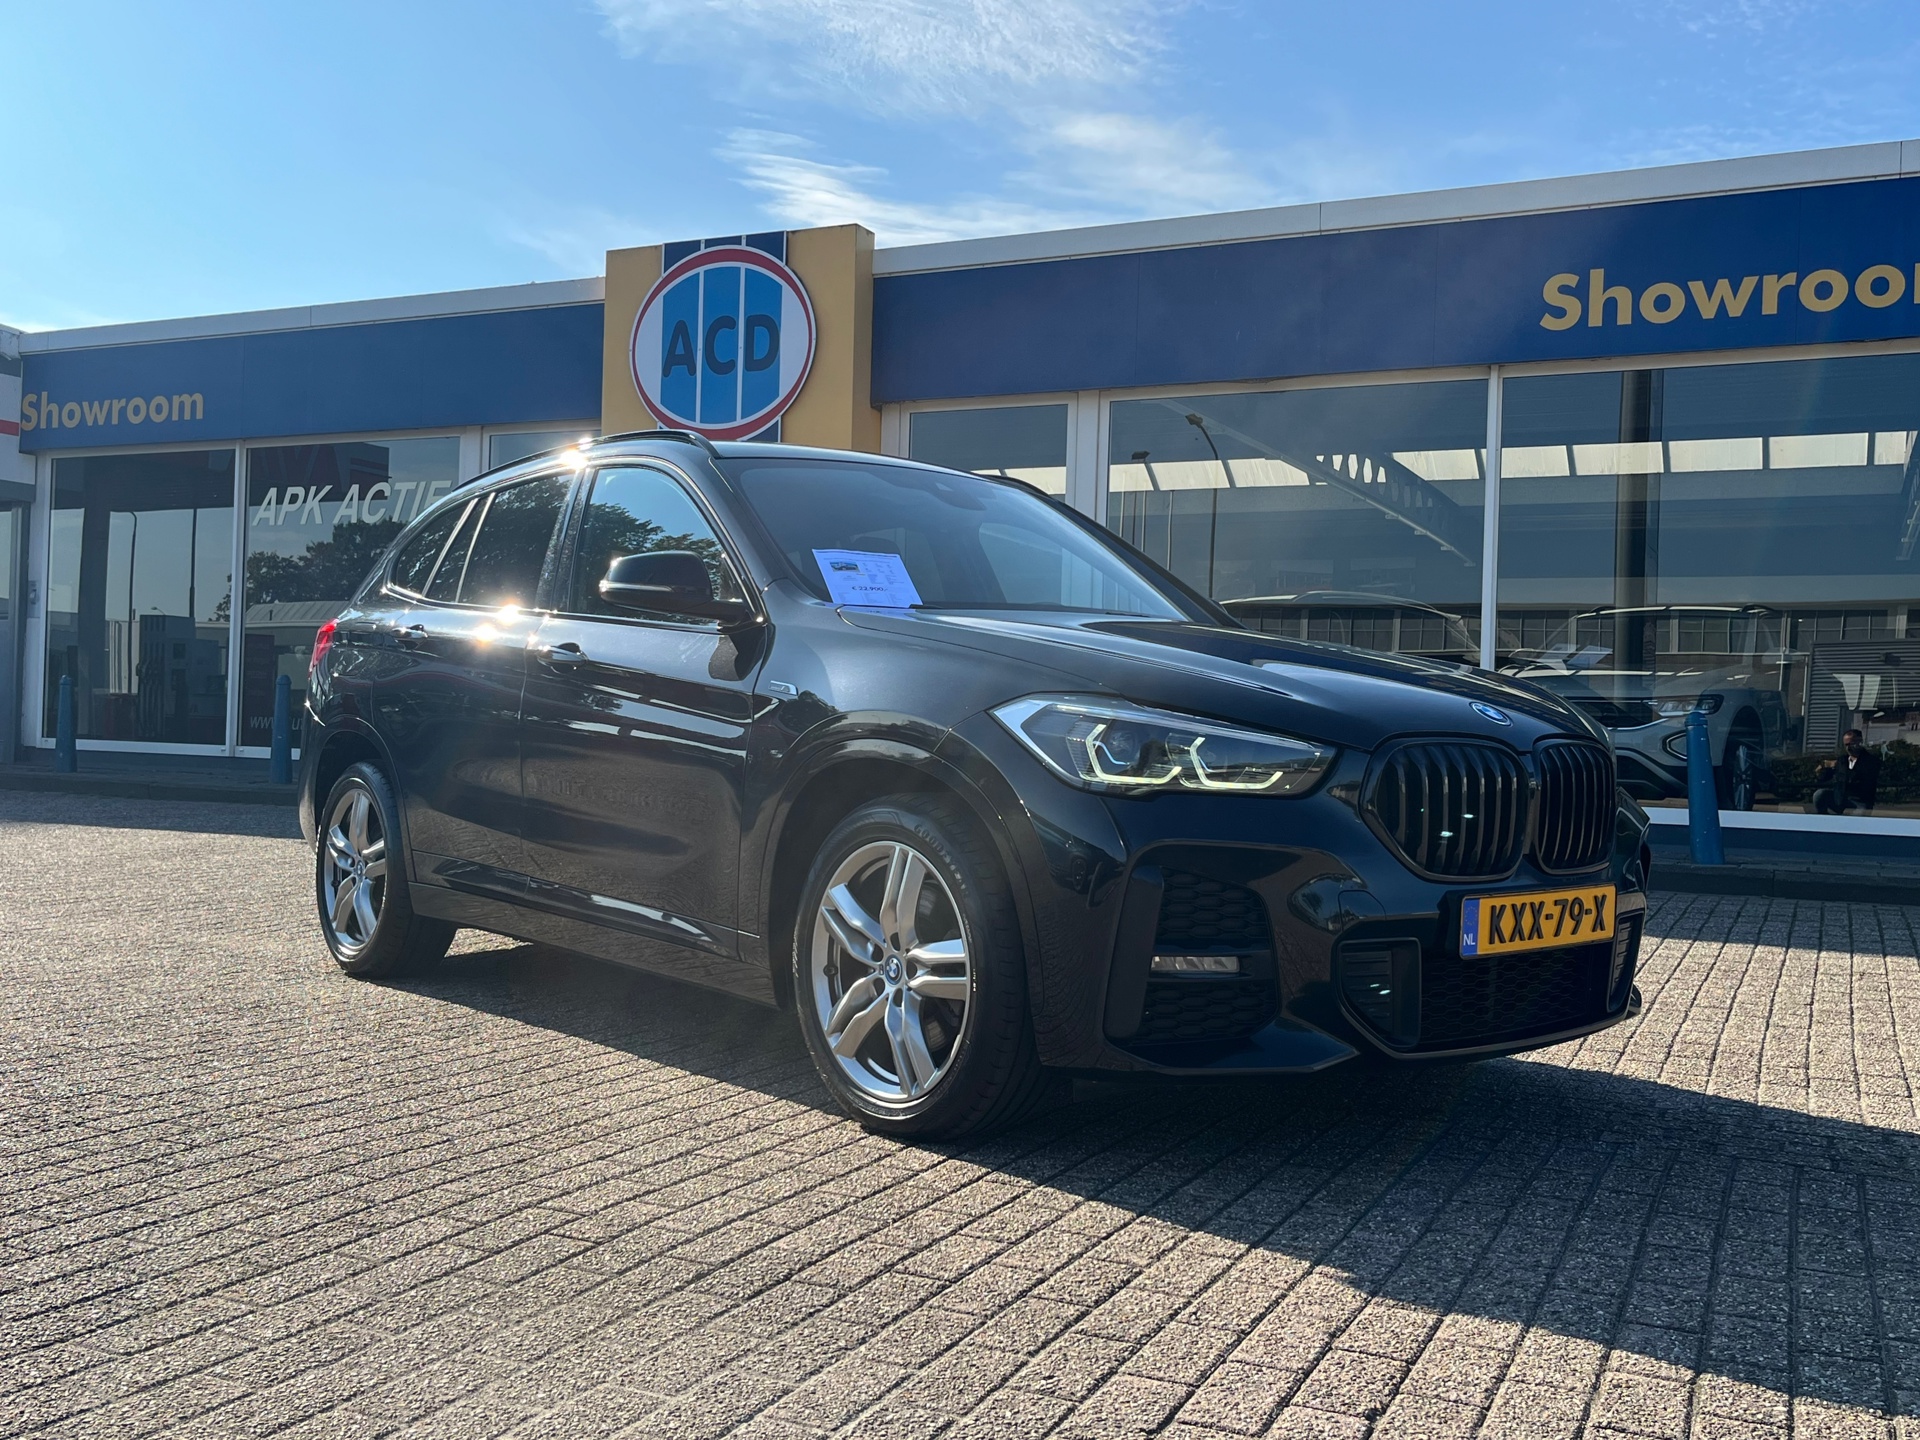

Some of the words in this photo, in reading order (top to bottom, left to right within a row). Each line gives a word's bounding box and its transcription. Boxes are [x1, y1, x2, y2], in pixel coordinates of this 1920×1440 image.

[1539, 263, 1920, 331] Showroo
[662, 314, 780, 378] ACD
[20, 391, 204, 431] Showroom
[252, 484, 333, 526] APK
[1463, 933, 1476, 946] NL
[1488, 894, 1608, 945] KXX-79-X
